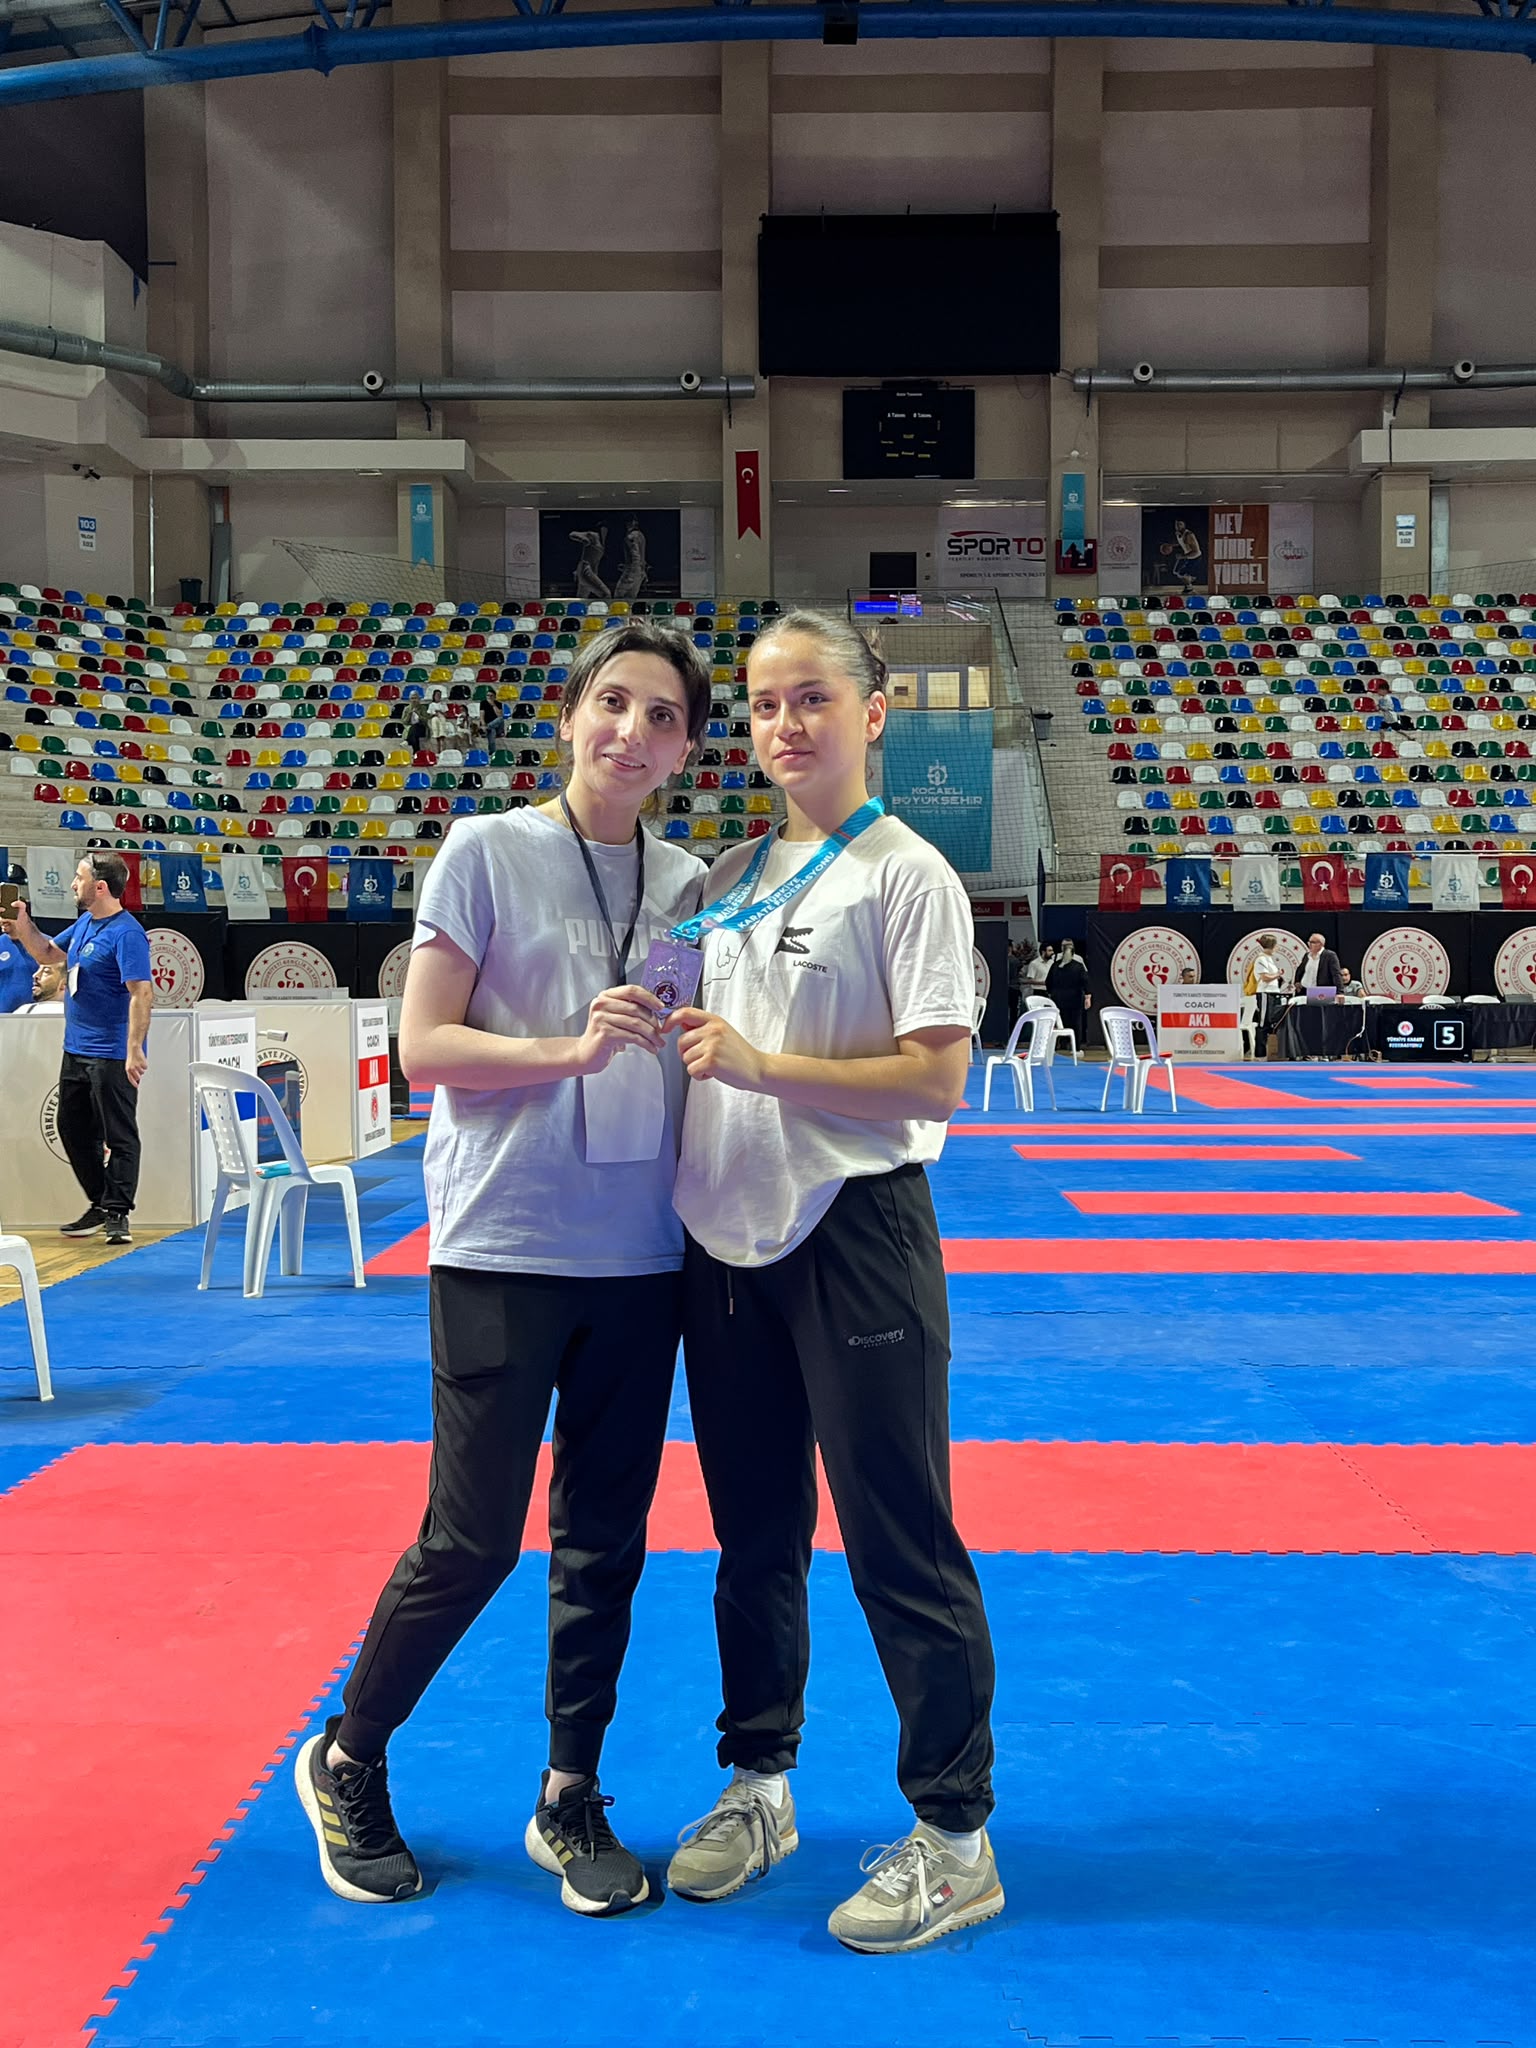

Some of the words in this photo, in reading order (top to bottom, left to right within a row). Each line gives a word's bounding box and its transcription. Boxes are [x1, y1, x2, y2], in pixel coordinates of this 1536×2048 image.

[80, 519, 95, 530] 103
[947, 538, 1047, 556] SPORTO
[1213, 561, 1265, 585] YÜKSEL
[737, 903, 776, 930] KARATE
[774, 851, 836, 908] FEDERASYONU
[763, 876, 801, 905] TÜRKİYE
[793, 960, 828, 973] LACOSTE
[1184, 1001, 1215, 1009] COACH
[1189, 1013, 1211, 1027] AKA
[1442, 1026, 1456, 1045] 5
[44, 1099, 58, 1144] TÜRKİYE
